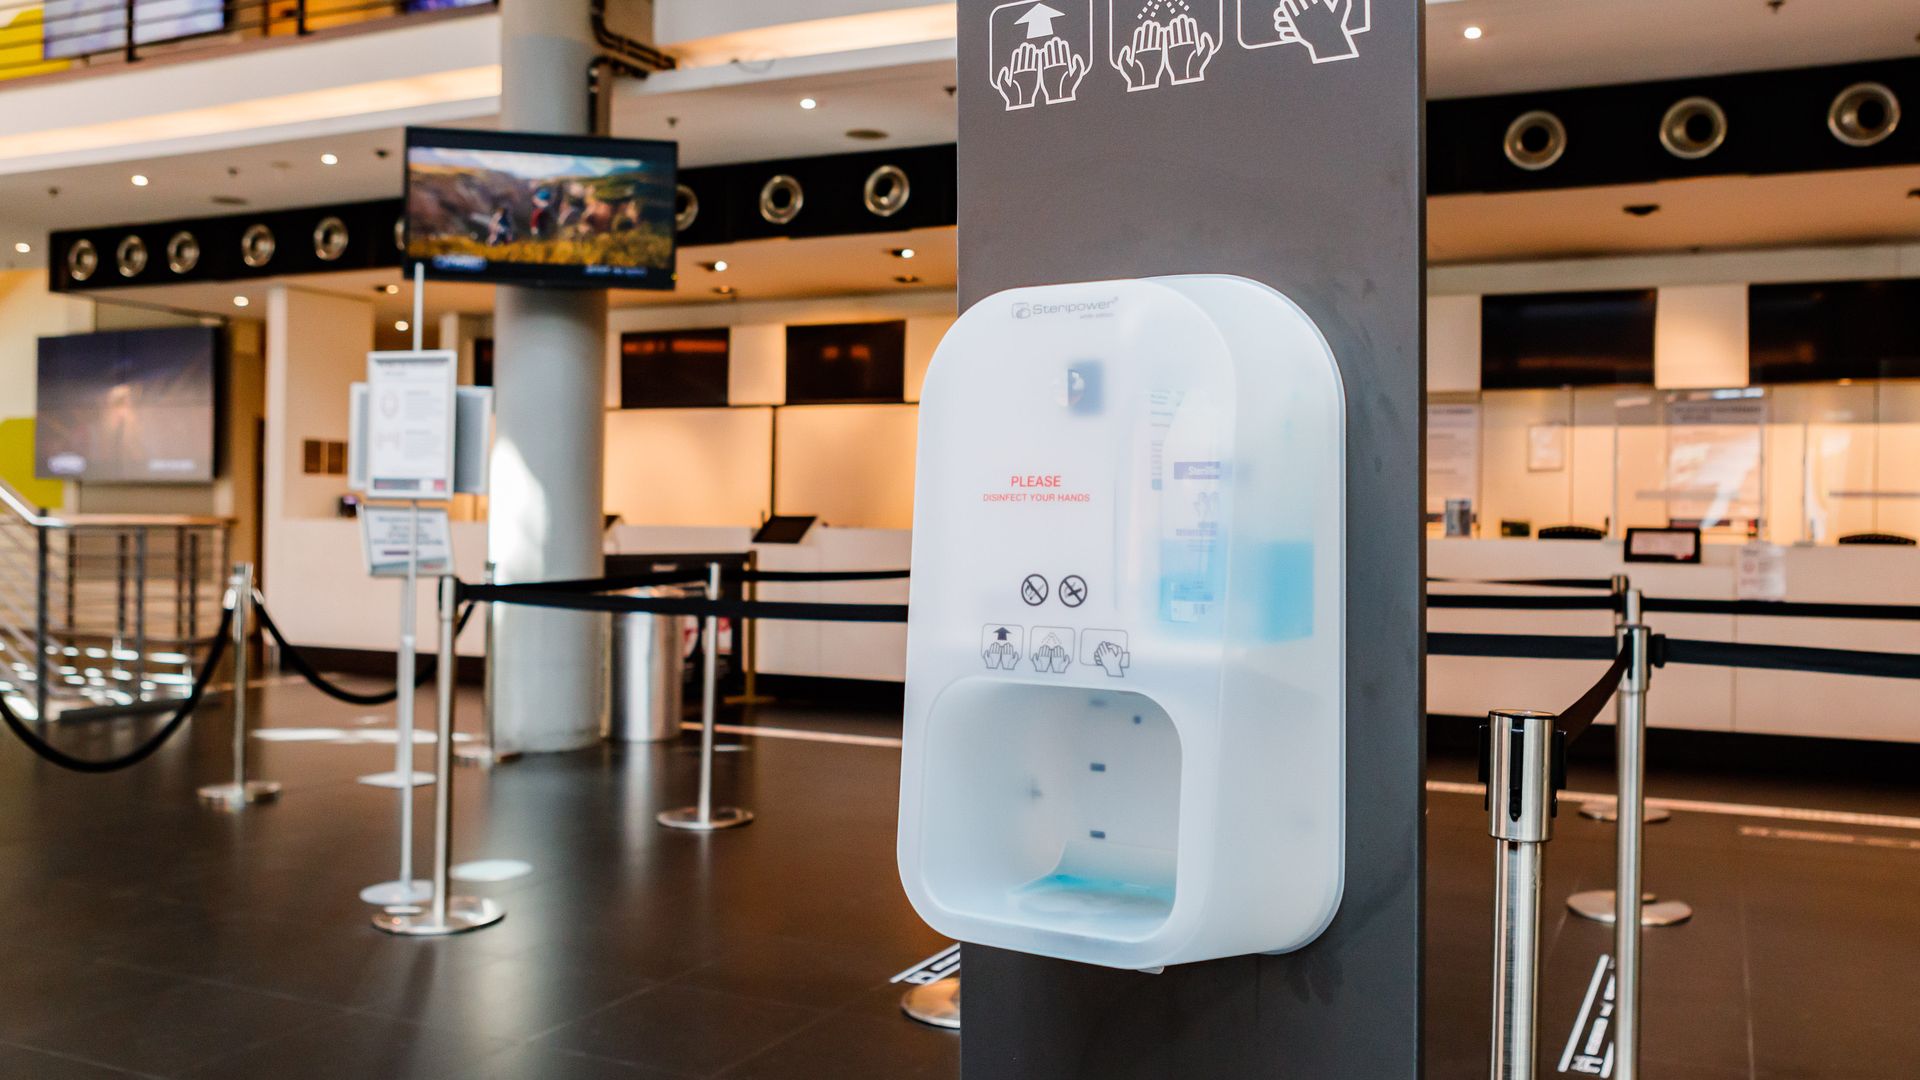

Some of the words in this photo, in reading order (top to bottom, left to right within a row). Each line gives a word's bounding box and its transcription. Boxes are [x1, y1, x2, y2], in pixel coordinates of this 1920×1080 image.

[1011, 475, 1061, 487] PLEASE
[983, 493, 1027, 502] DISINFECT
[1030, 493, 1055, 502] YOUR
[1057, 493, 1090, 502] HANDS
